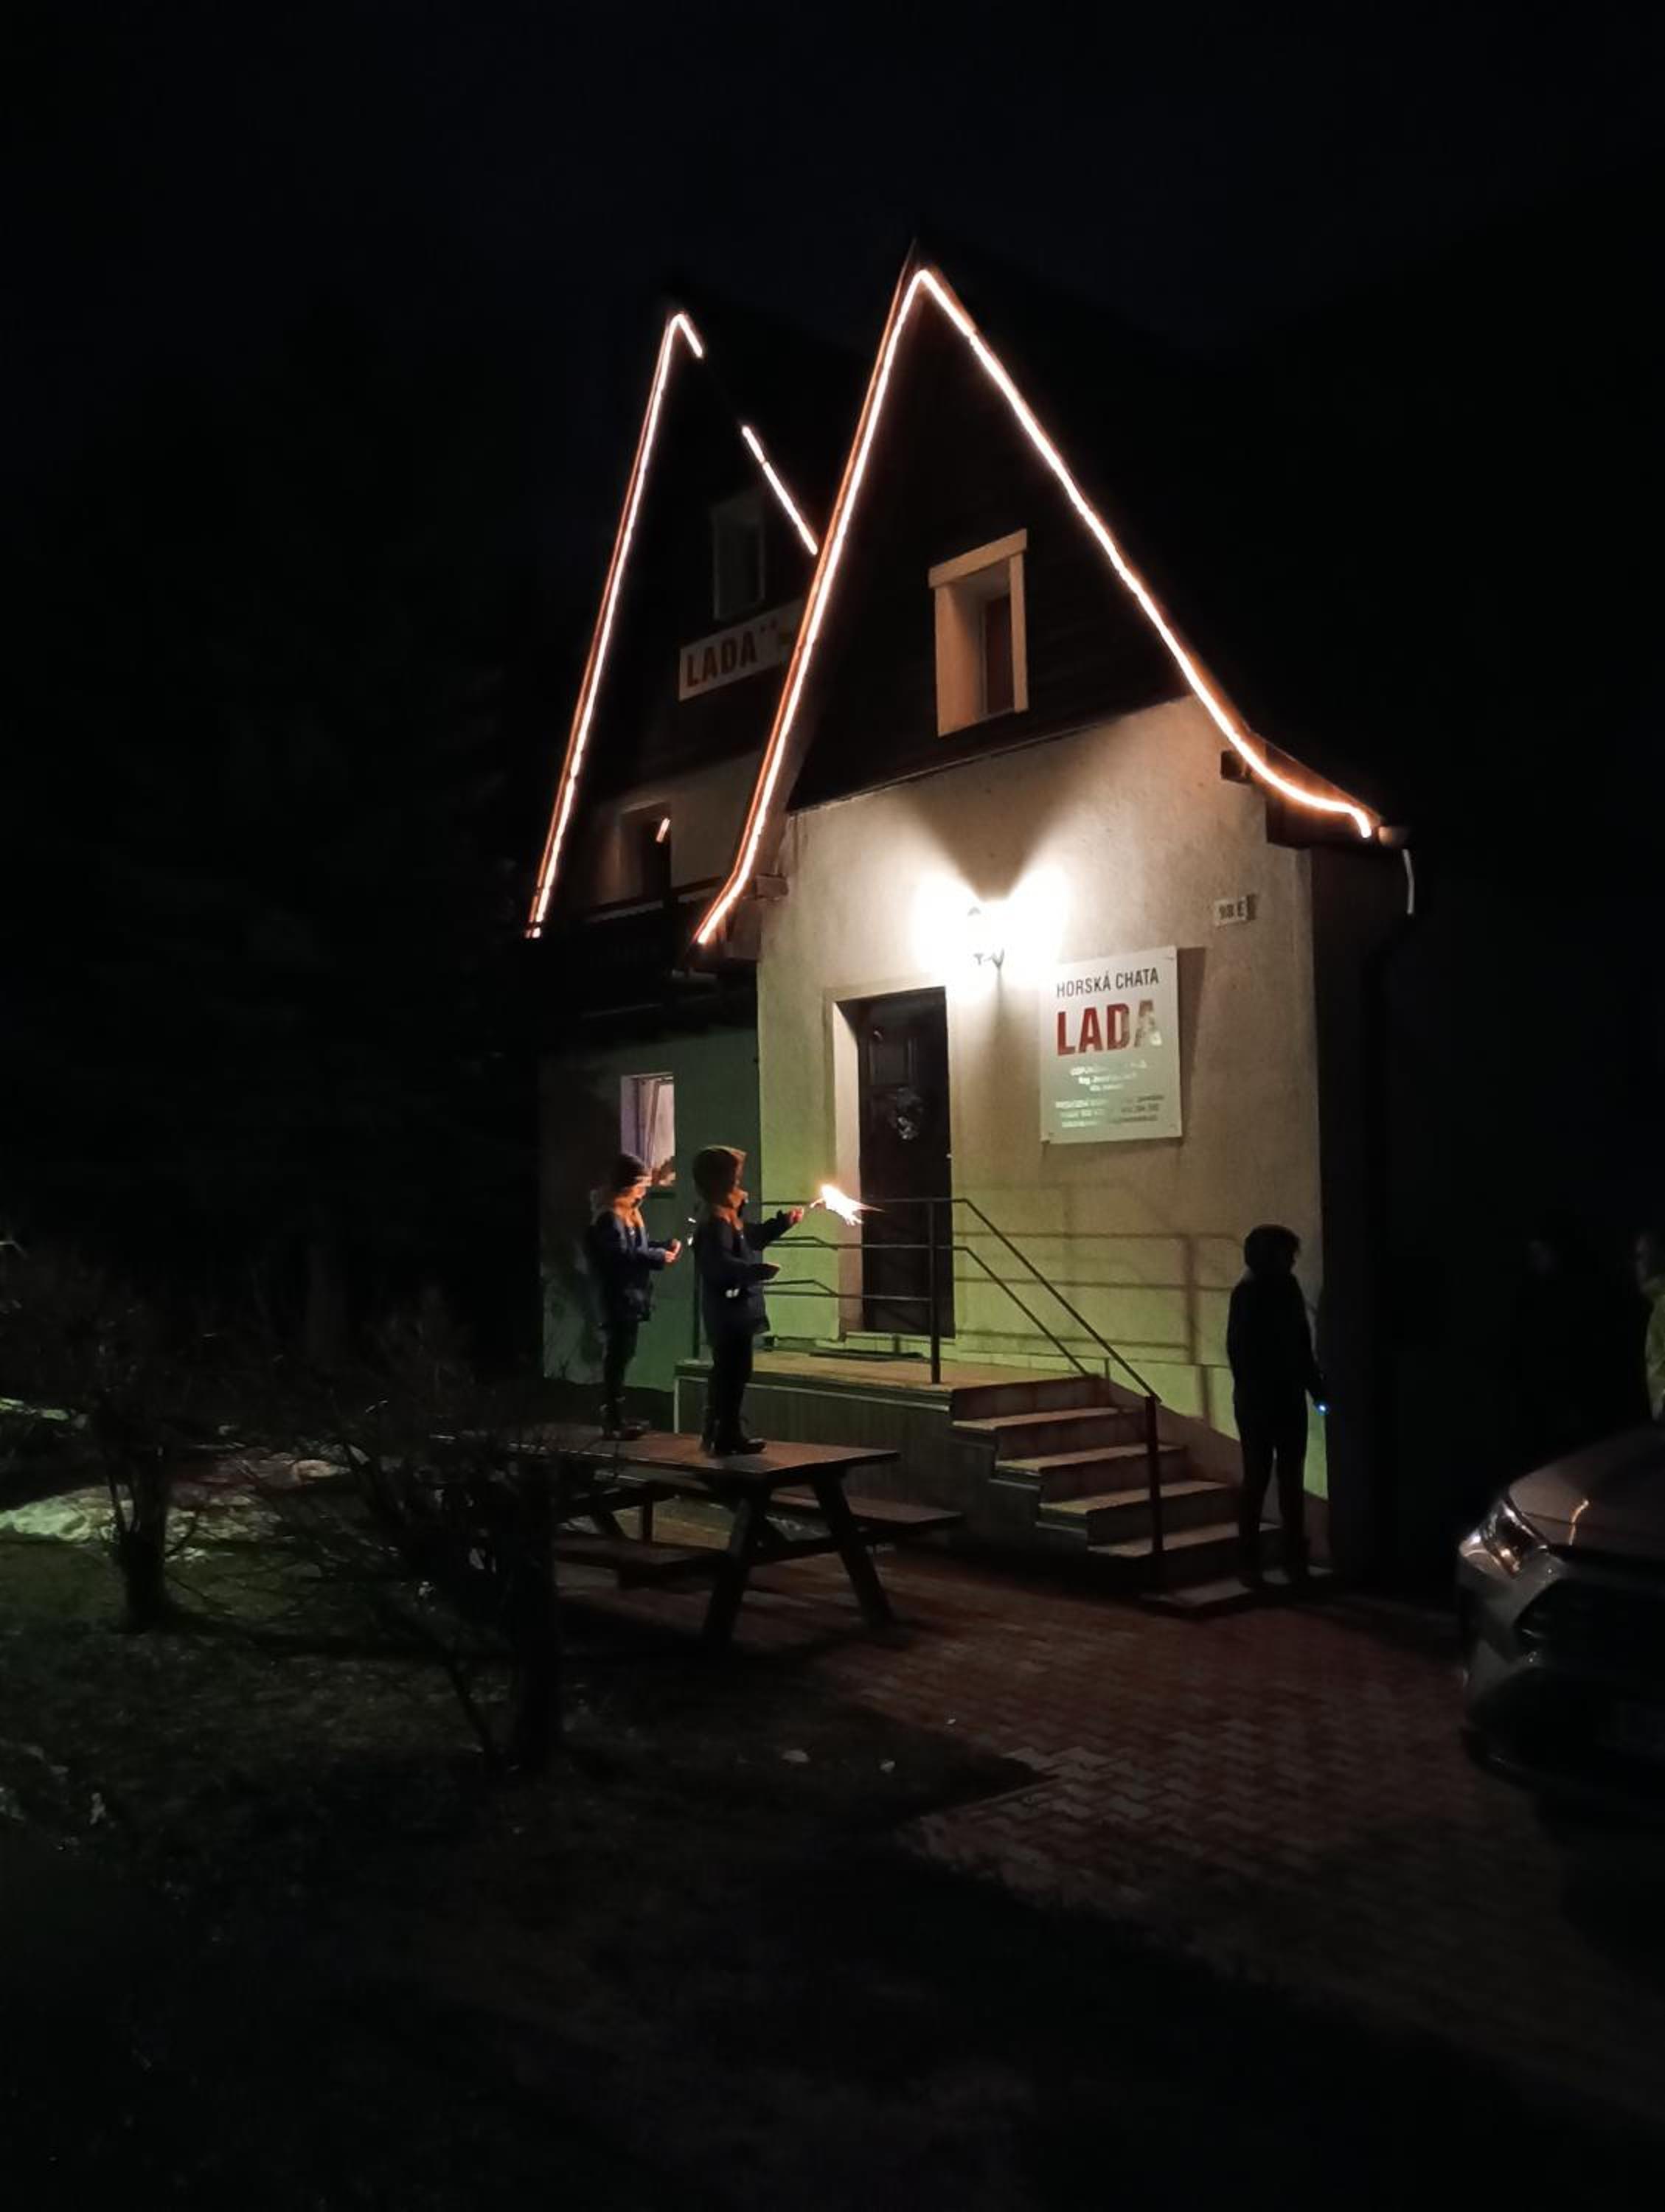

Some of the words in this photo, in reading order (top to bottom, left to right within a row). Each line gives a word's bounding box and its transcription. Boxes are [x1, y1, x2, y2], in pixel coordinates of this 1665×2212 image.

[686, 630, 757, 688] LADA
[1057, 971, 1110, 997] HORSKÁ
[1116, 967, 1159, 990] CHATA
[1057, 1000, 1161, 1056] LADA
